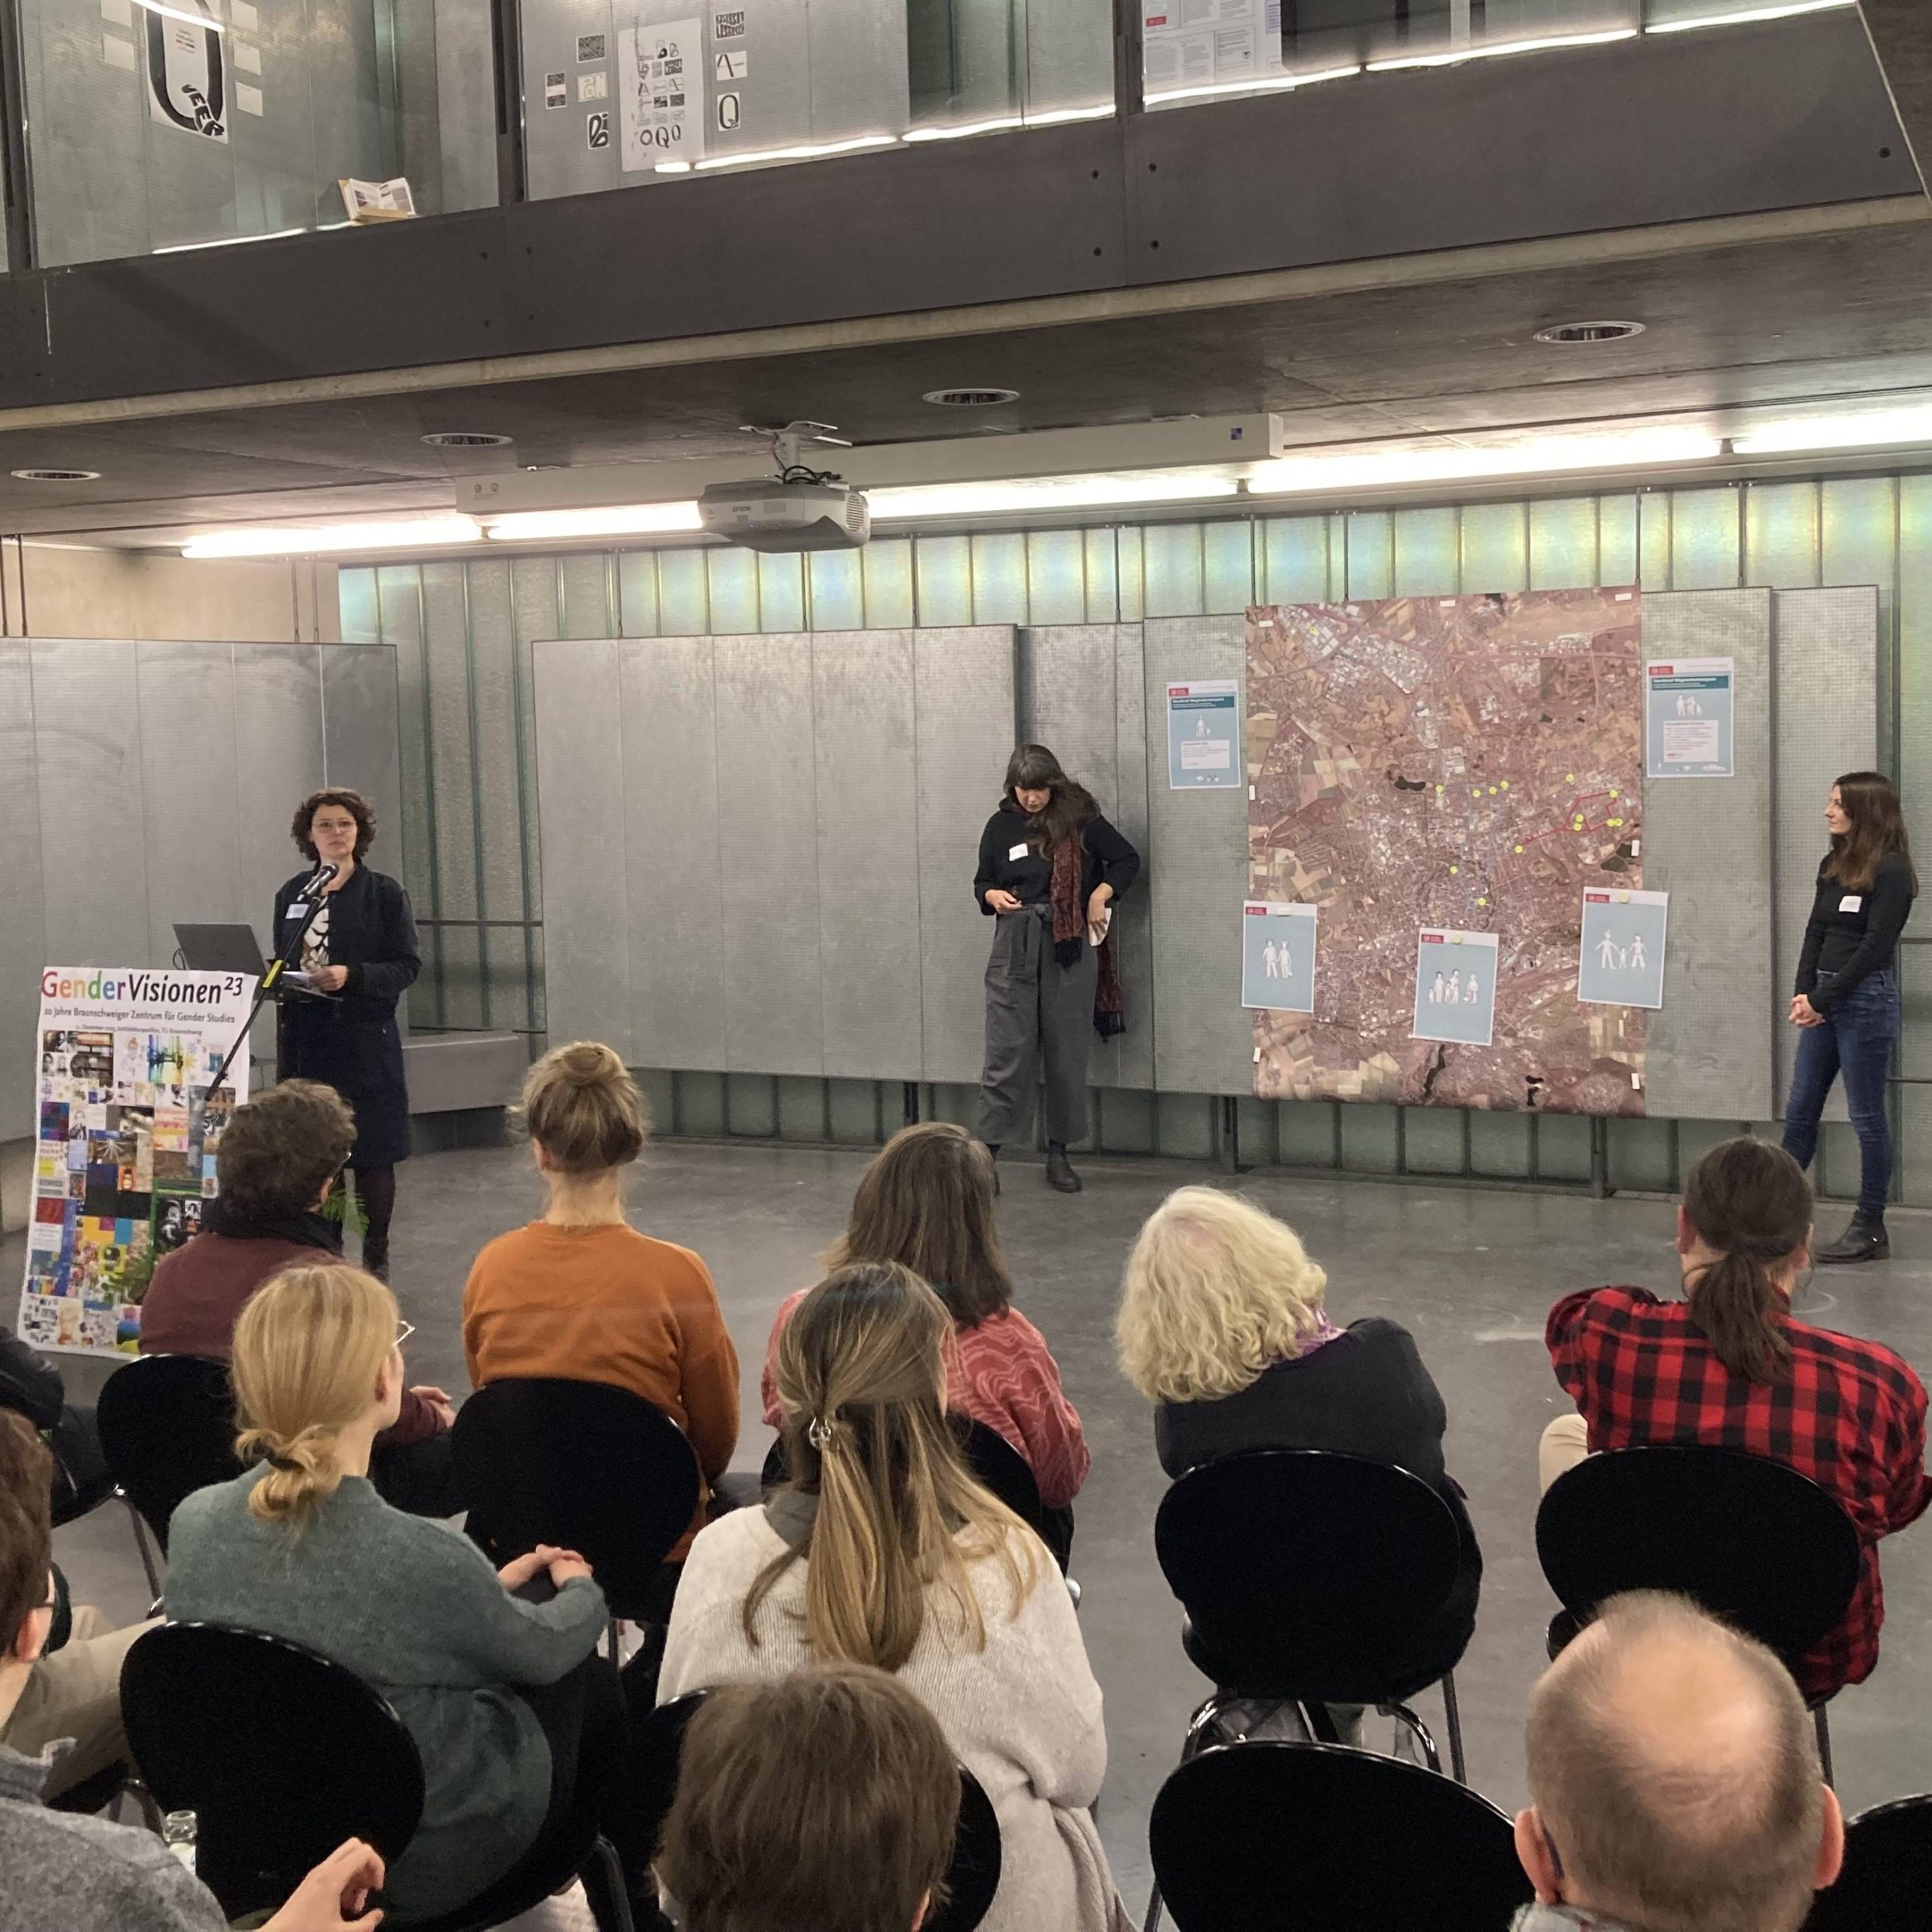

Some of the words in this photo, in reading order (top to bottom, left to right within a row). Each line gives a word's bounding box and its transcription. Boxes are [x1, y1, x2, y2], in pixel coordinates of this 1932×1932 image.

[53, 1008, 72, 1018] Jahre
[74, 1008, 129, 1021] Braunschweiger
[131, 1011, 162, 1020] Zentrum
[165, 1011, 176, 1020] für
[177, 1012, 205, 1022] Gender
[207, 1013, 235, 1023] Studies
